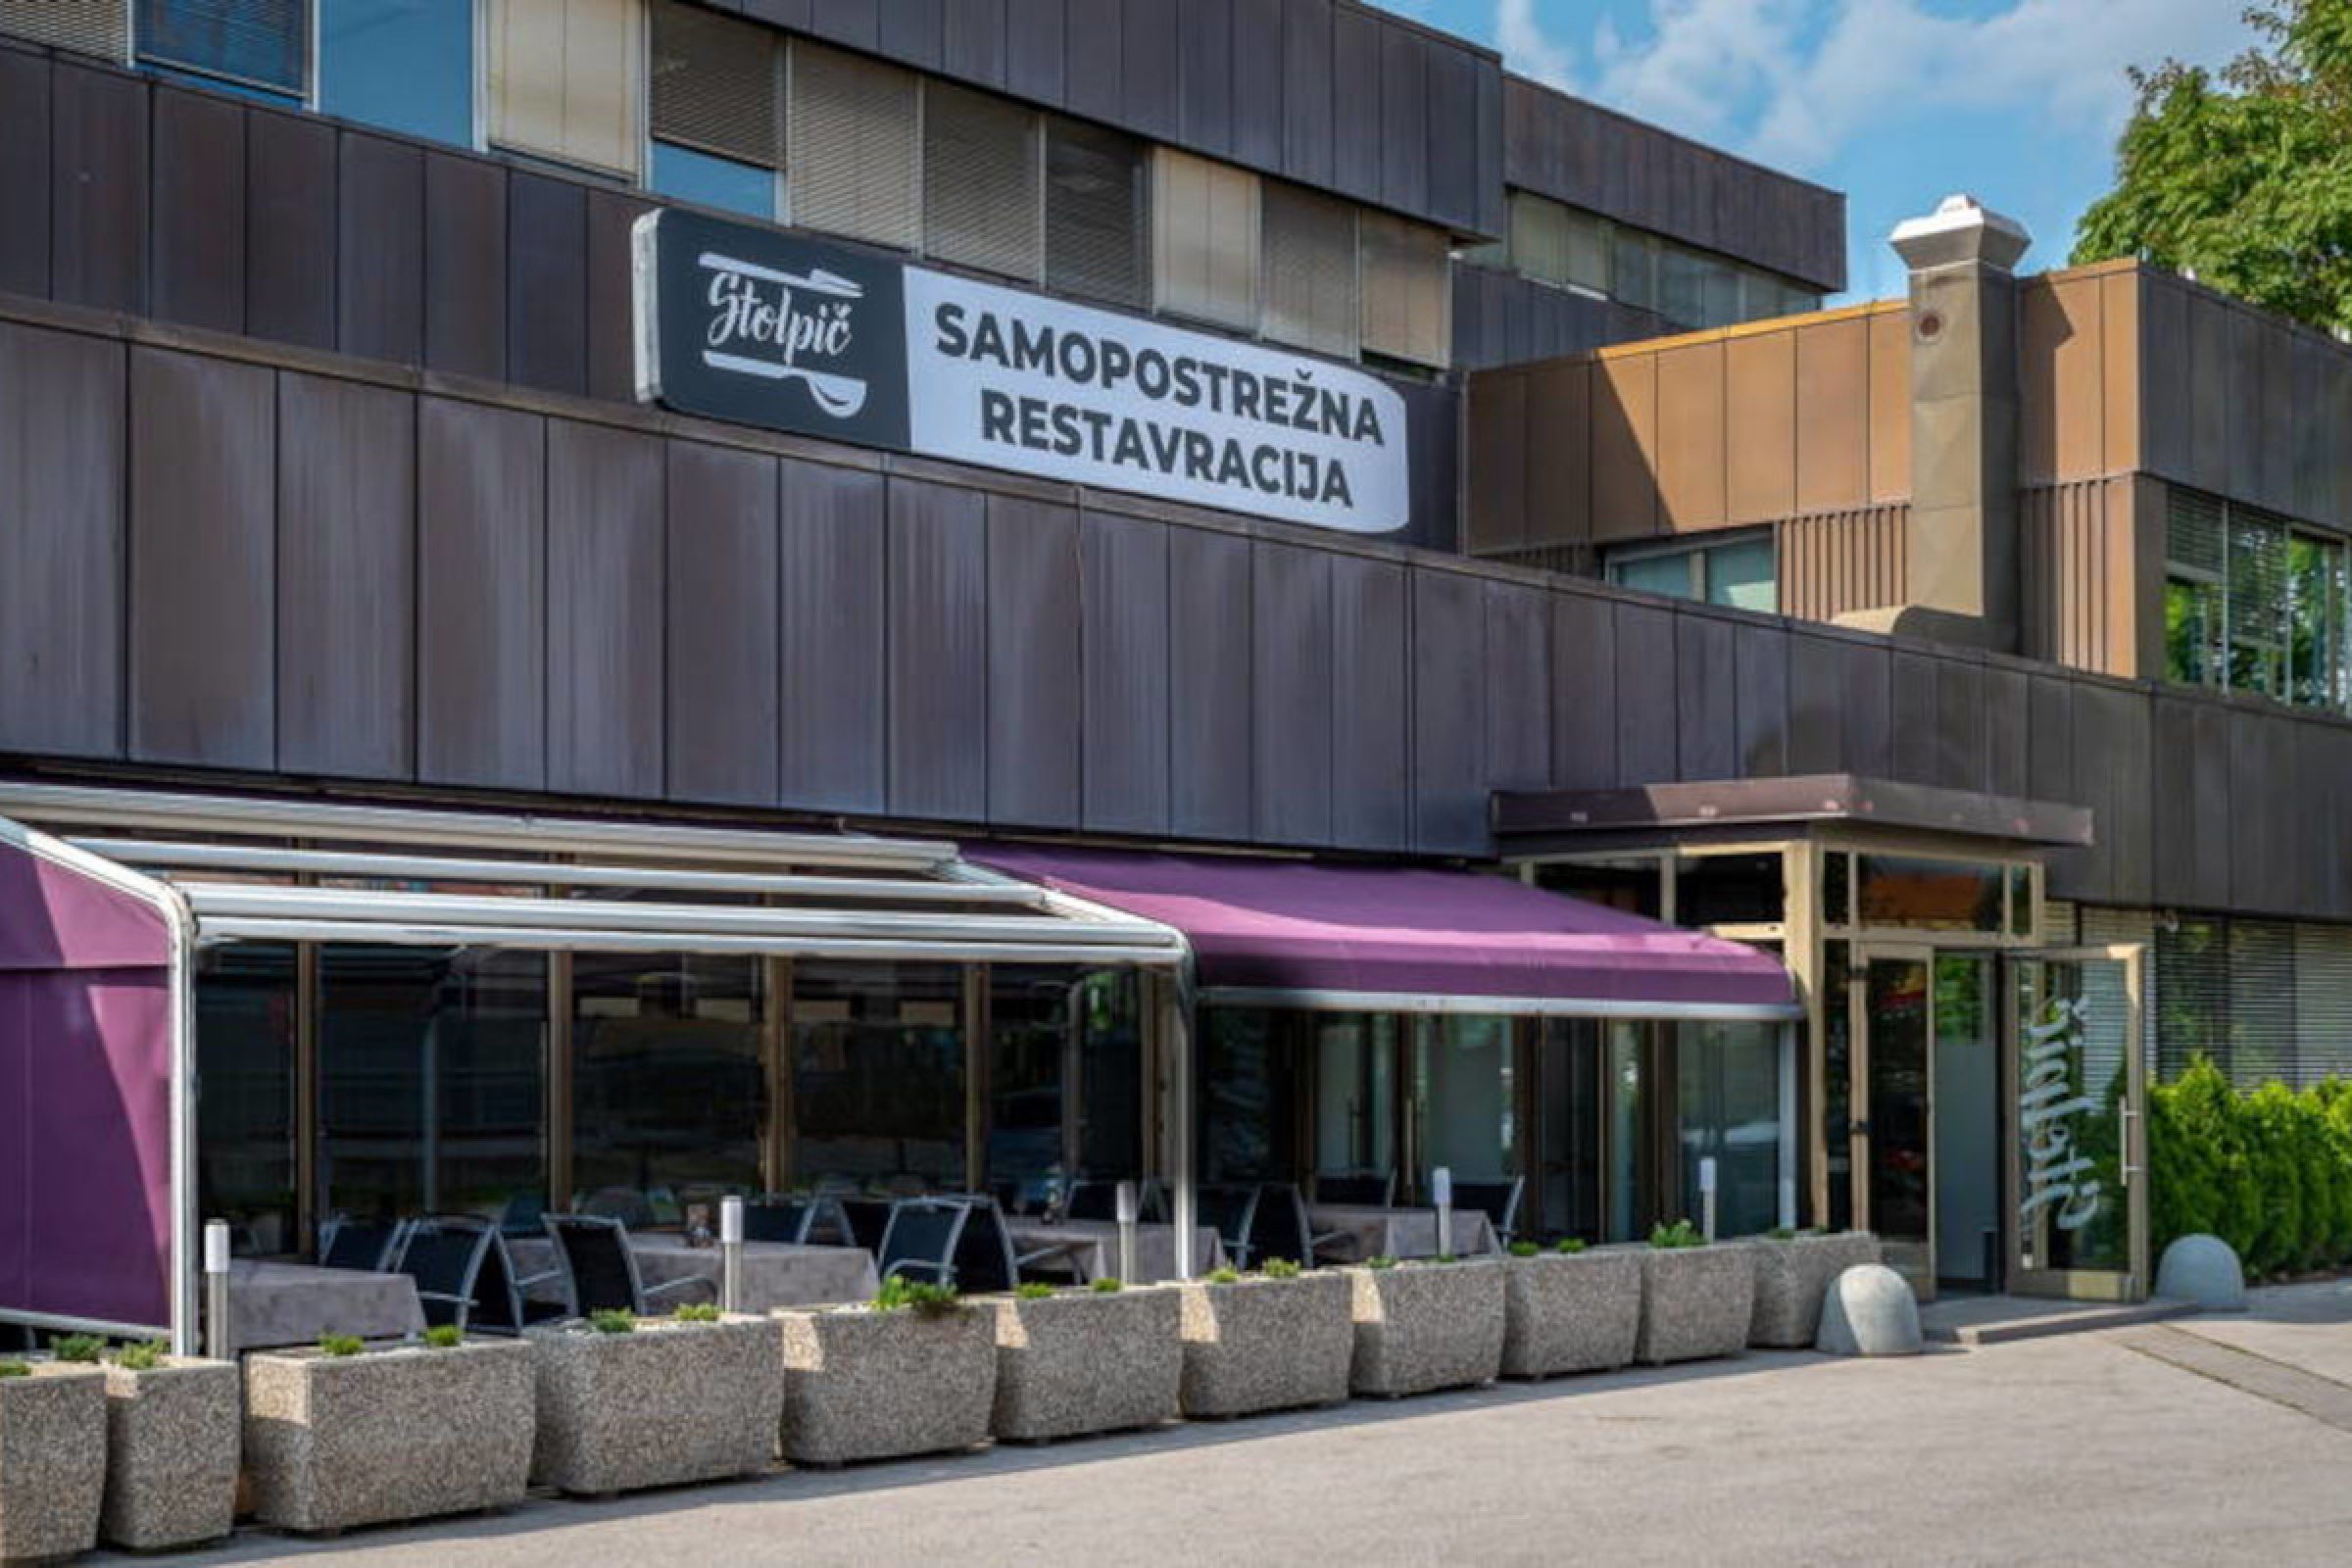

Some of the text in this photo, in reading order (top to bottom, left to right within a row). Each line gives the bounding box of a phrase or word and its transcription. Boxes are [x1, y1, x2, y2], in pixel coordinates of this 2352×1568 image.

[707, 270, 854, 368] Stolpič
[935, 302, 1385, 446] SAMOPOSTREŽNA
[982, 388, 1353, 509] RESTAVRACIJA
